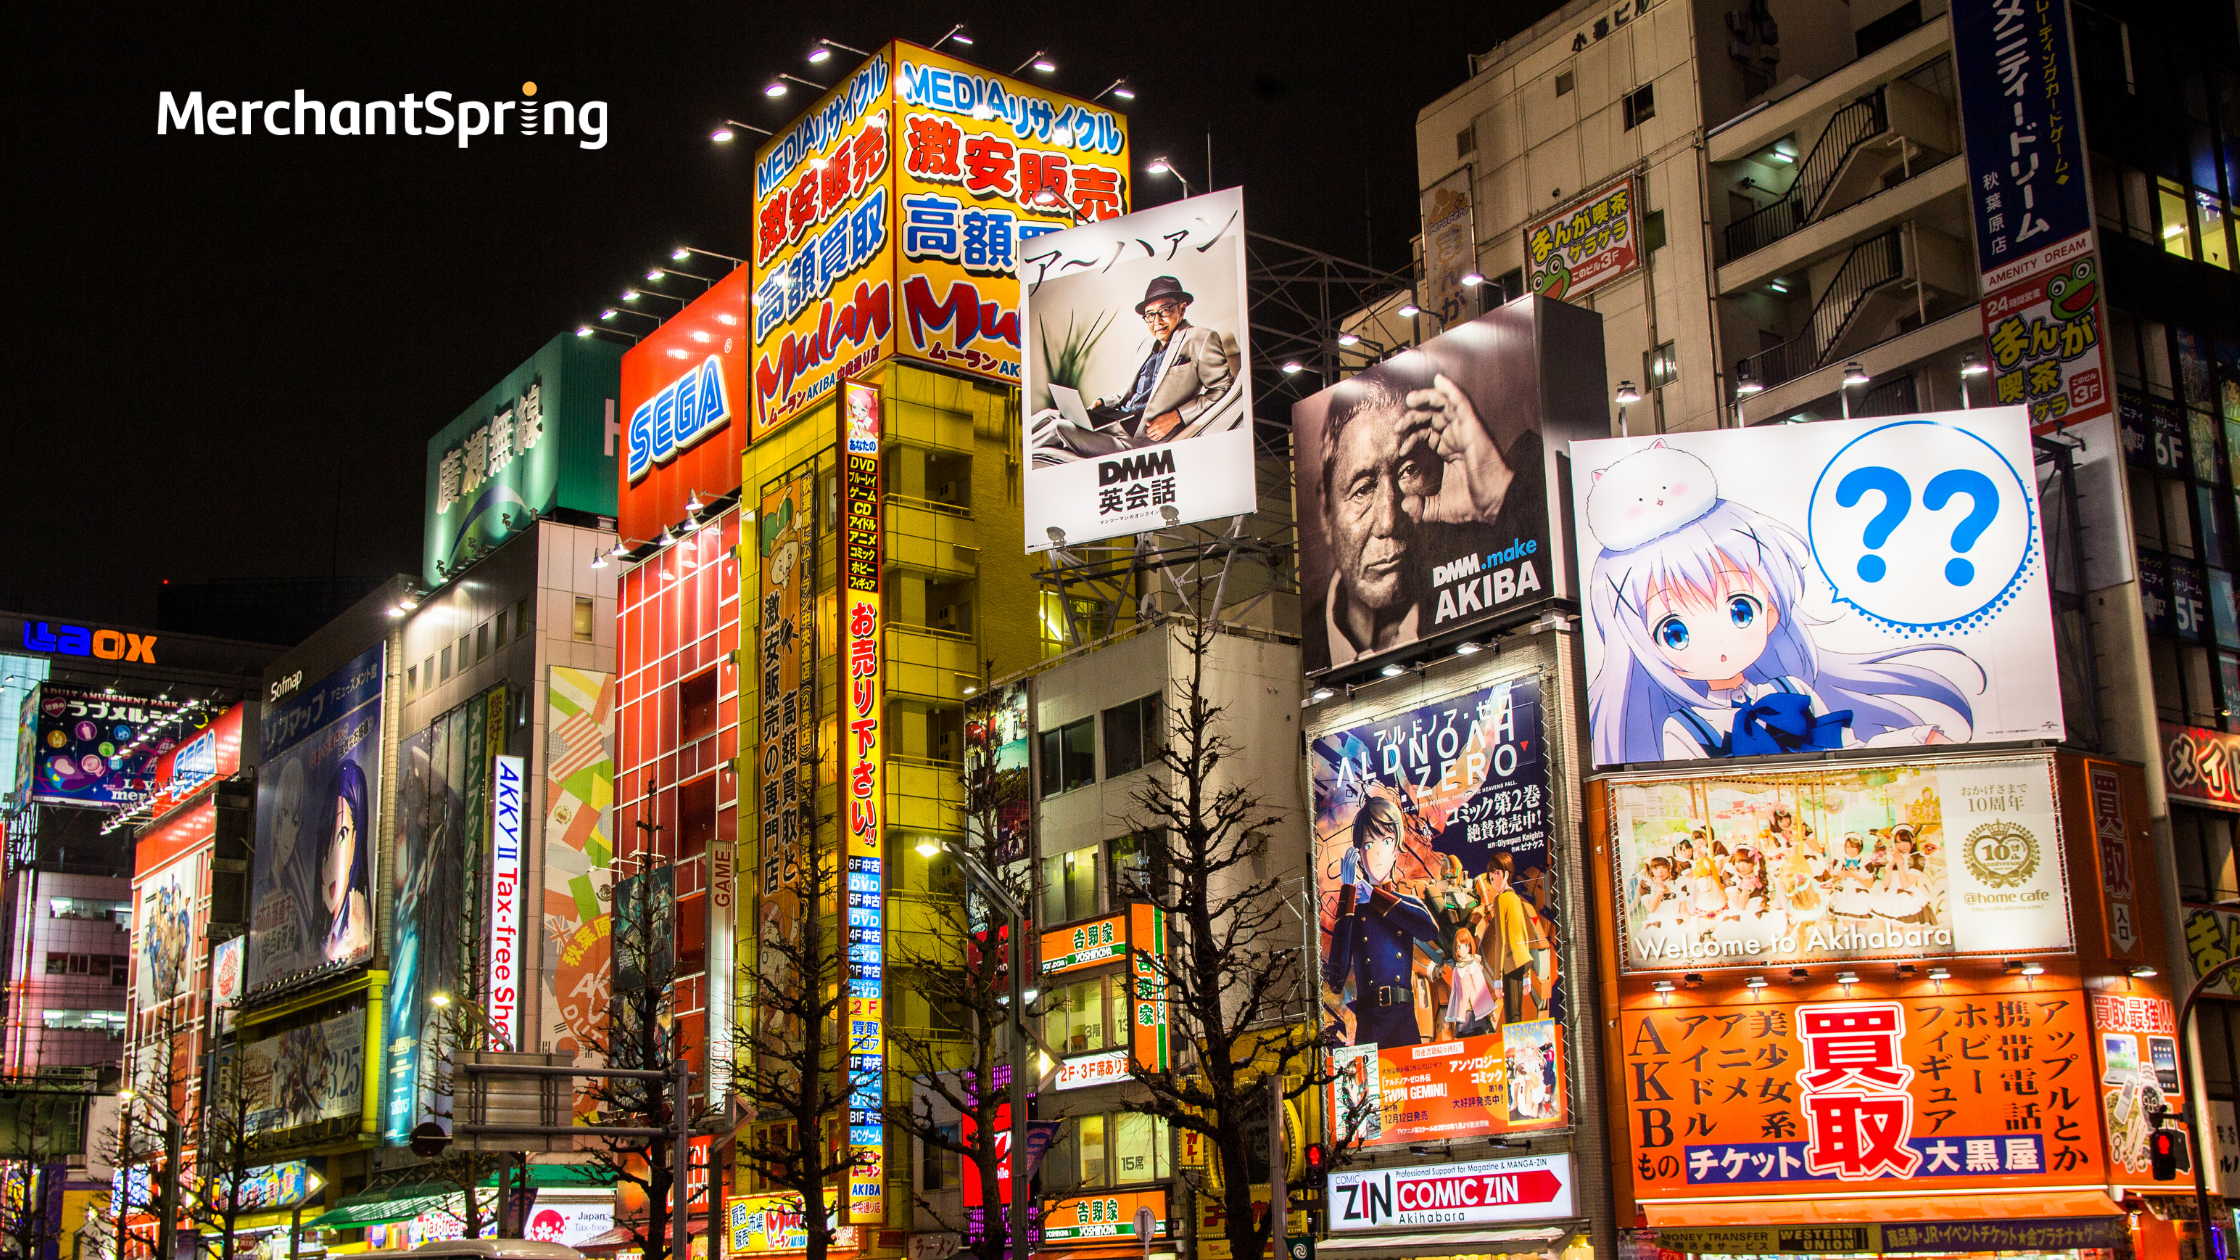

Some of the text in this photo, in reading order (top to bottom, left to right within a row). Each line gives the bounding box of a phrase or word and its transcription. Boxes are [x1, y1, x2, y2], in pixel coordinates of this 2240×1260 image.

[906, 115, 1122, 222] 激安販売
[758, 114, 888, 265] 激安販売
[1983, 172, 2007, 255] 秋葉原店
[1531, 190, 1629, 264] まんが喫茶
[1569, 220, 1626, 261] ゲラゲラ
[756, 187, 884, 344] 高額買取
[1989, 238, 2086, 287] AMENITY DREAM
[756, 281, 890, 425] Mulan
[1990, 313, 2097, 367] まんが
[1997, 360, 2059, 405] 喫茶
[2074, 384, 2099, 403] 3F
[627, 355, 730, 482] SEGA
[849, 439, 876, 452] あなたの
[2155, 432, 2183, 468] 6F
[850, 456, 875, 473] DVD
[1098, 449, 1176, 487] DMM
[849, 471, 877, 488] ブルーレイ
[849, 486, 876, 502] ゲーム
[1099, 475, 1176, 516] 英会話
[854, 501, 872, 515] CD
[849, 516, 876, 531] アイドル
[849, 531, 876, 547] アニメ
[850, 546, 875, 562] コミック
[851, 561, 875, 576] ホビー
[850, 576, 876, 591] フィギュア
[1434, 560, 1541, 625] AKIBA
[2175, 596, 2203, 632] 5F
[271, 670, 302, 702] Sofmap
[265, 689, 325, 751] ソフマップ
[1961, 784, 2028, 797] おかげさまで
[1446, 784, 1541, 826] コミック第2巻
[1968, 795, 2025, 813] 10周年
[1466, 810, 1542, 843] 絶賛発売中!
[2092, 770, 2133, 899] 買取
[496, 761, 519, 979] AKKY Tax-free
[715, 849, 731, 908] GAME
[849, 859, 880, 873] 6F 中古
[851, 880, 879, 891] DVD
[1964, 889, 2049, 905] @home cafe
[849, 893, 880, 908] 5F 中古
[851, 914, 879, 927] DVD
[2117, 907, 2130, 941] 入口
[561, 915, 611, 968] 秋葉原
[849, 929, 880, 943] 4F 中古
[1634, 921, 1953, 963] Welcome to Akihabara
[862, 965, 880, 978] 中古
[851, 1021, 879, 1037] 買取
[1085, 1023, 1101, 1038] 3階
[1714, 1012, 1752, 1101] アニメ
[1954, 1004, 1991, 1094] ホビー
[850, 1056, 881, 1071] 1F 中古
[1449, 1057, 1502, 1073] アンソロジー
[1471, 1069, 1503, 1084] コミック
[1675, 1013, 1718, 1137] アイドル
[1750, 1009, 1797, 1139] 美少女系
[1916, 1006, 1958, 1136] フィギュア
[1993, 1000, 2042, 1131] 携帯電話
[1383, 1086, 1408, 1103] TWIN
[1800, 1003, 1921, 1179] 買取
[2036, 999, 2089, 1173] アップルとか
[850, 1111, 865, 1123] B1F
[1384, 1110, 1429, 1125] 12月12日発売
[850, 1129, 881, 1143] PCゲーム
[1121, 1155, 1144, 1171] 15席
[1396, 1168, 1431, 1178] Professional
[1432, 1165, 1455, 1177] Support
[1457, 1165, 1466, 1173] for
[1468, 1163, 1499, 1175] Magazine
[1507, 1158, 1547, 1169] MANGA-ZIN
[1689, 1146, 1802, 1180] チケット
[1925, 1138, 2040, 1173] 大黒屋
[851, 1166, 880, 1178] ムーラン
[1336, 1174, 1360, 1185] COMIC
[851, 1183, 881, 1196] AKIBA
[1336, 1172, 1392, 1225] ZIN
[1399, 1176, 1519, 1210] COMIC ZIN
[1399, 1211, 1465, 1224] Akihabara
[1661, 1232, 1768, 1242] MONEY TRANSFER
[1780, 1228, 1853, 1240] WESTERN
[1804, 1239, 1855, 1250] UNION
